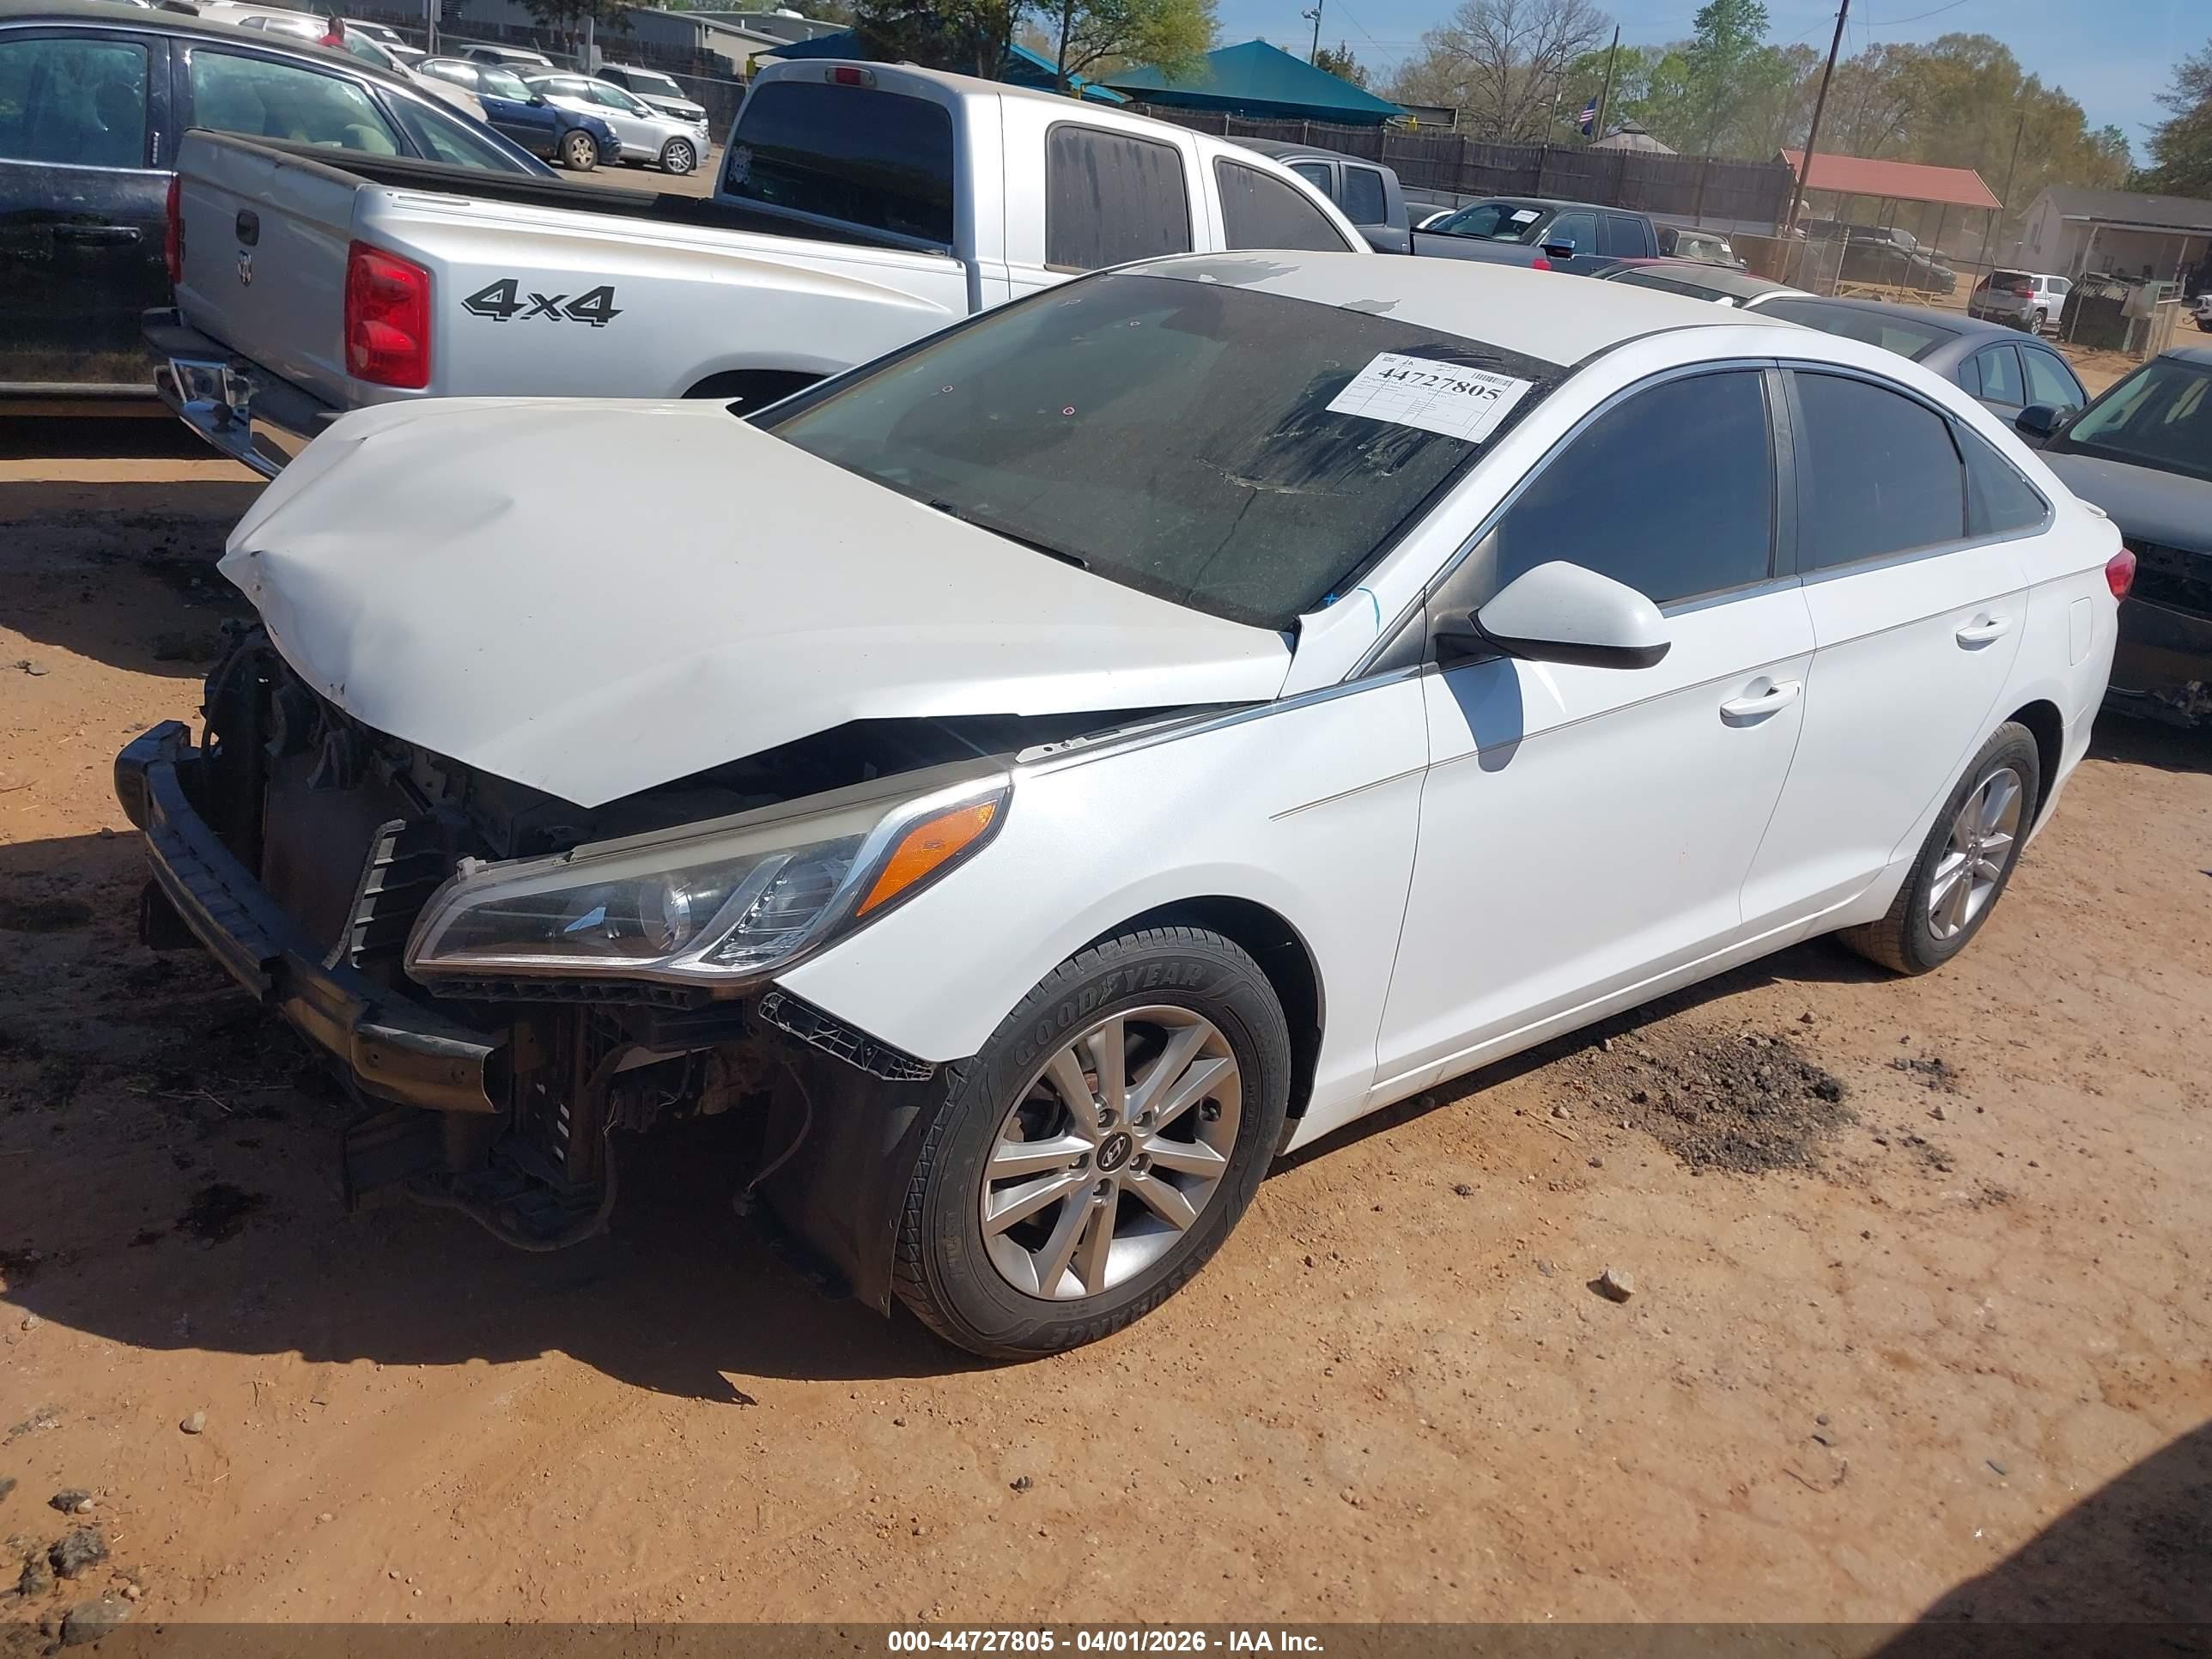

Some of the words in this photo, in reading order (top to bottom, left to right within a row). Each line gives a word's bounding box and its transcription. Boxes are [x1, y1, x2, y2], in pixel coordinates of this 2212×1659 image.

[460, 278, 624, 328] 4x4
[1378, 368, 1504, 400] 44727805
[1013, 962, 1206, 1066] GOODYEAR
